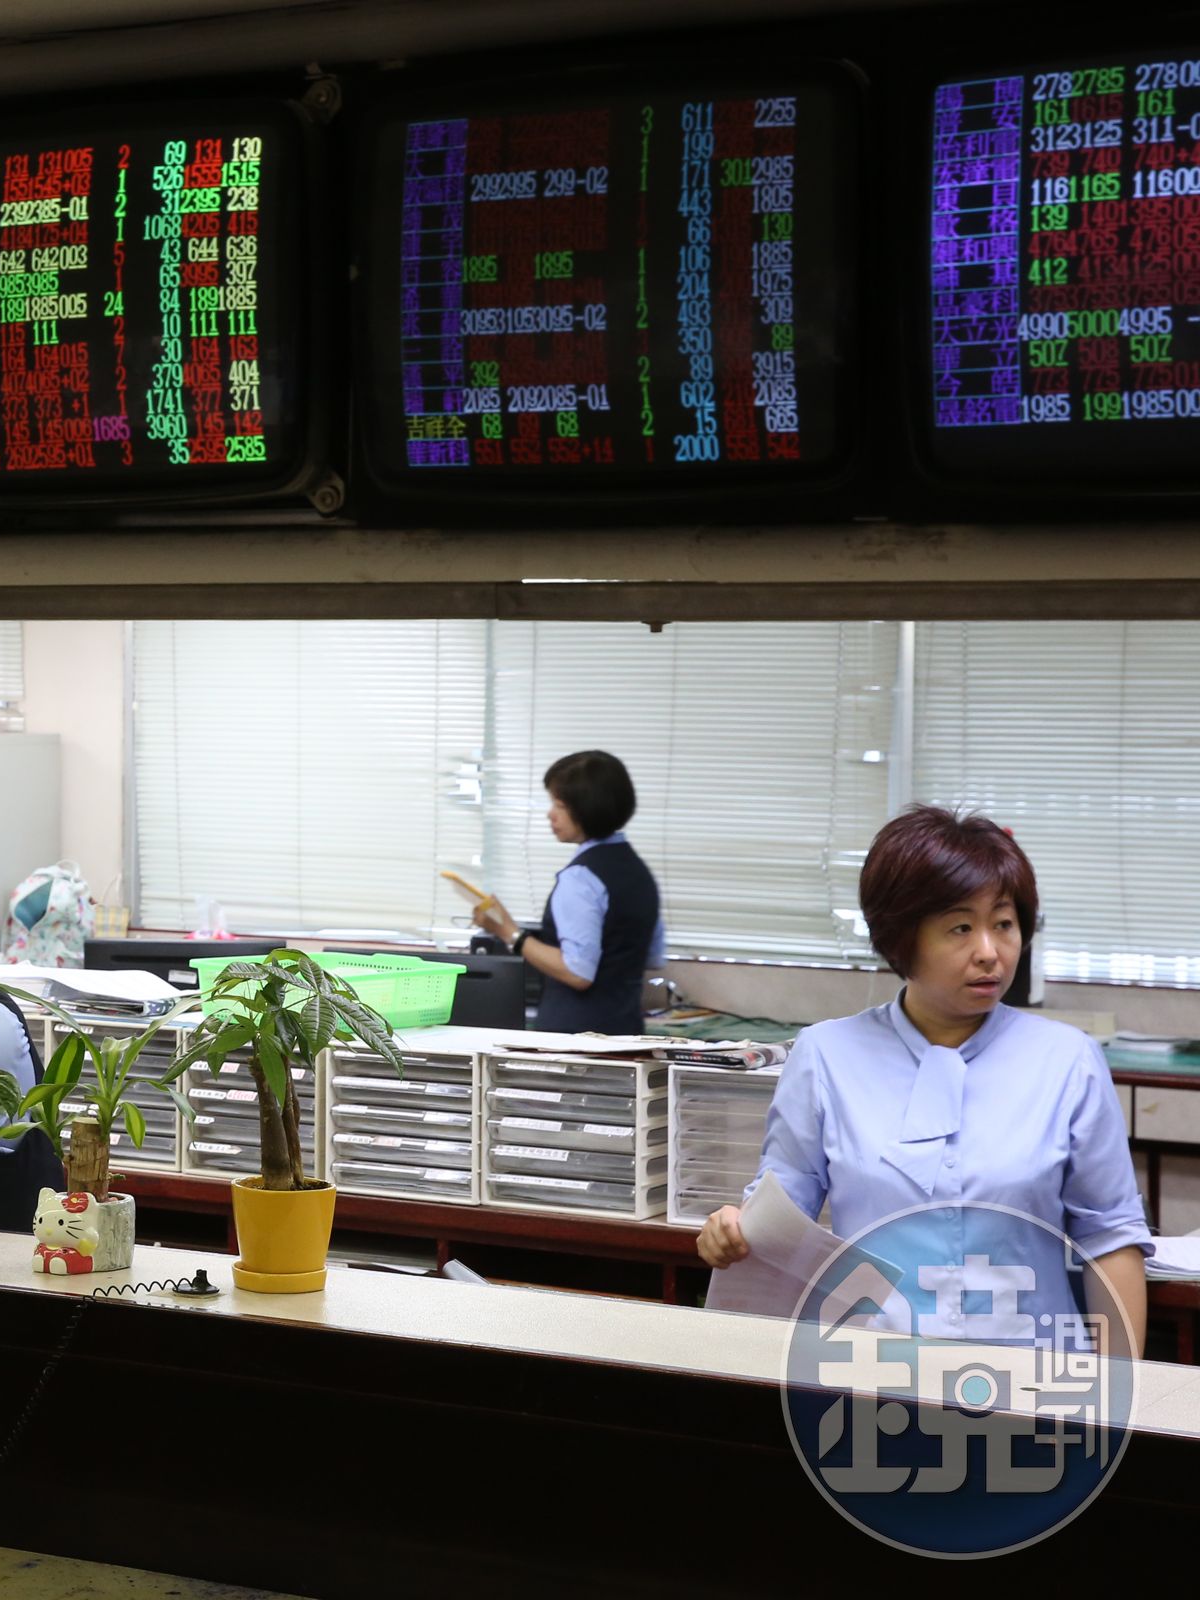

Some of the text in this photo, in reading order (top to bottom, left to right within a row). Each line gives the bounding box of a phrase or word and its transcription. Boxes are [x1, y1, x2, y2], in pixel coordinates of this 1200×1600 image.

[1032, 72, 1072, 101] 278
[640, 105, 653, 134] 3
[681, 101, 713, 132] 611
[1034, 89, 1175, 126] 161 161
[1132, 115, 1174, 144] 311
[118, 144, 131, 169] 2
[164, 140, 186, 165] 69
[232, 137, 262, 162] 130
[118, 161, 260, 192] 1 526 1515
[1031, 173, 1121, 206] 116 1165
[114, 193, 127, 217] 2
[227, 186, 258, 211] 238
[143, 214, 182, 240] 1068
[1031, 204, 1068, 232] 139
[0, 249, 25, 274] 642
[161, 239, 180, 263] 43
[188, 236, 219, 262] 644
[226, 235, 257, 261] 636
[160, 260, 257, 288] 65 397
[1028, 257, 1068, 287] 412
[104, 288, 180, 316] 24 84
[33, 320, 59, 345] 111
[162, 313, 181, 338] 10
[190, 311, 219, 337] 111
[228, 309, 257, 335] 111
[1118, 306, 1172, 336] 4995
[161, 338, 182, 363] 30
[1029, 334, 1172, 368] 507 507
[152, 359, 259, 388] 379 404
[146, 385, 260, 414] 1741 371
[1021, 393, 1070, 423] 1985
[146, 413, 187, 439] 3960
[641, 410, 654, 436] 2
[694, 405, 717, 434] 15
[225, 435, 265, 462] 2585
[673, 434, 720, 462] 2000
